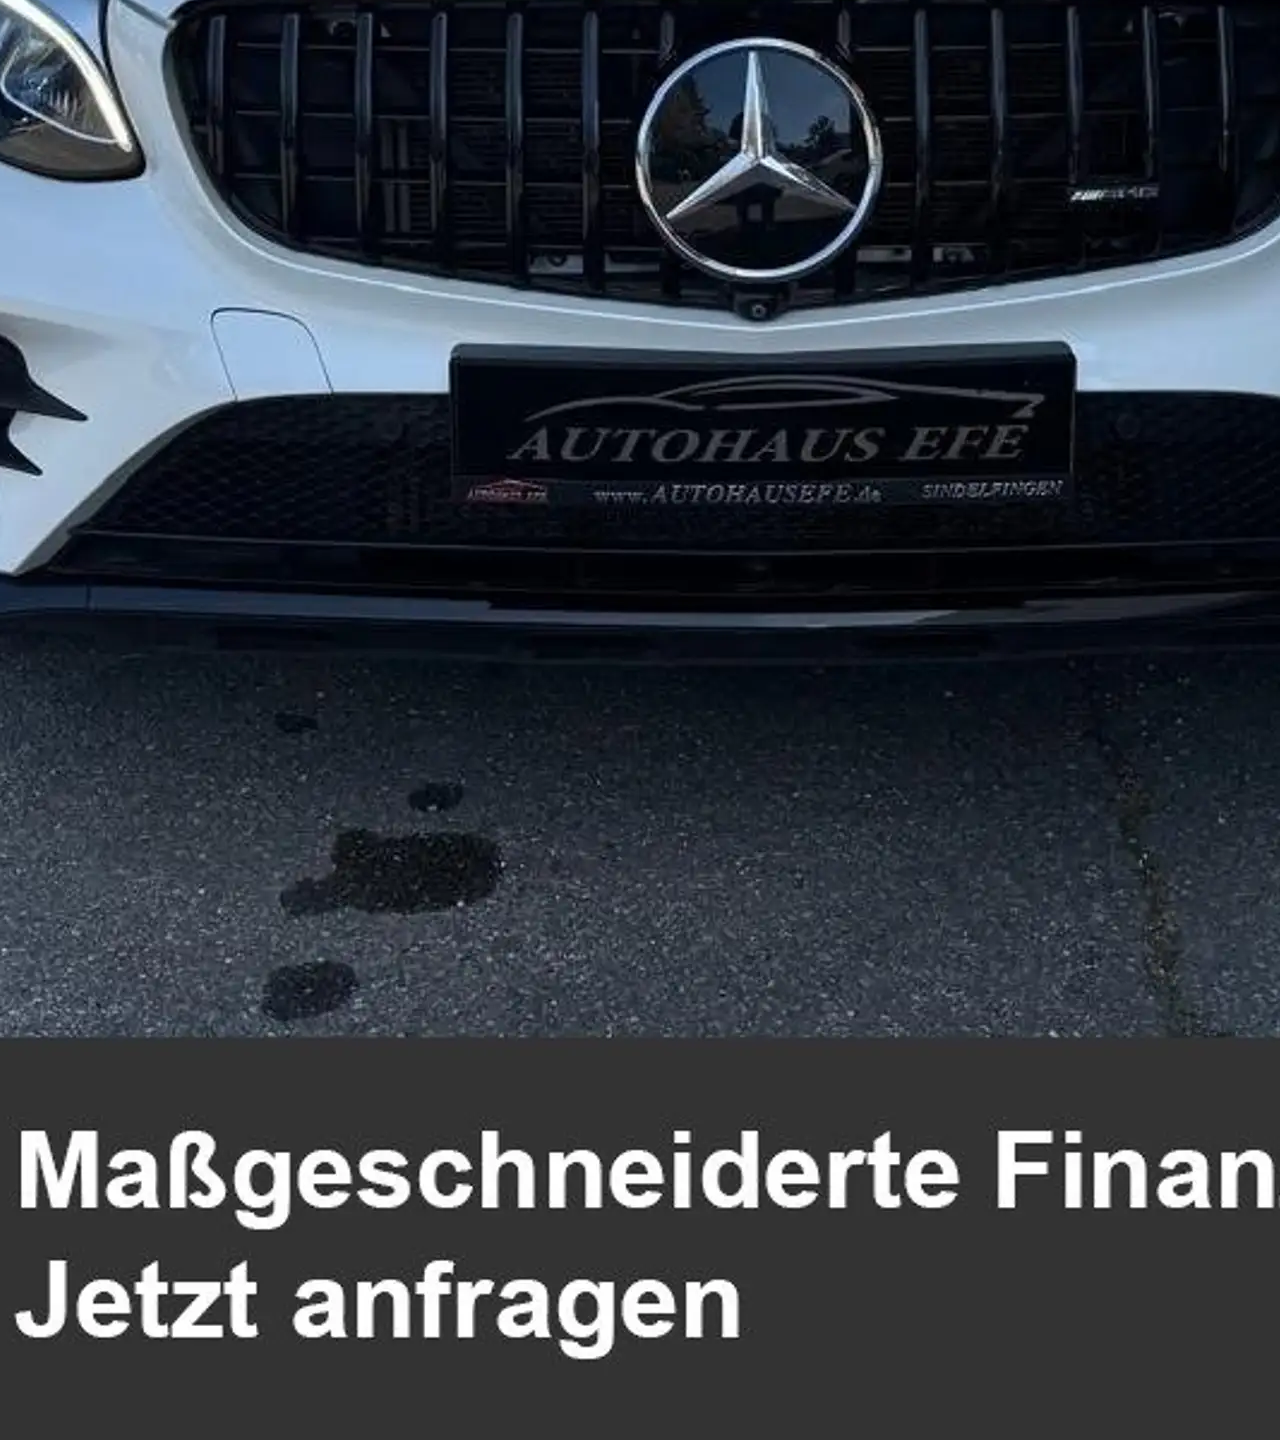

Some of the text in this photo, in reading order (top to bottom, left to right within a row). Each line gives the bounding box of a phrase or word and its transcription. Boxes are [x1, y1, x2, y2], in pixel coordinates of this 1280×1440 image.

[507, 424, 1029, 462] AUTOHAUS EFE
[921, 479, 1064, 499] SINDELFINGEN
